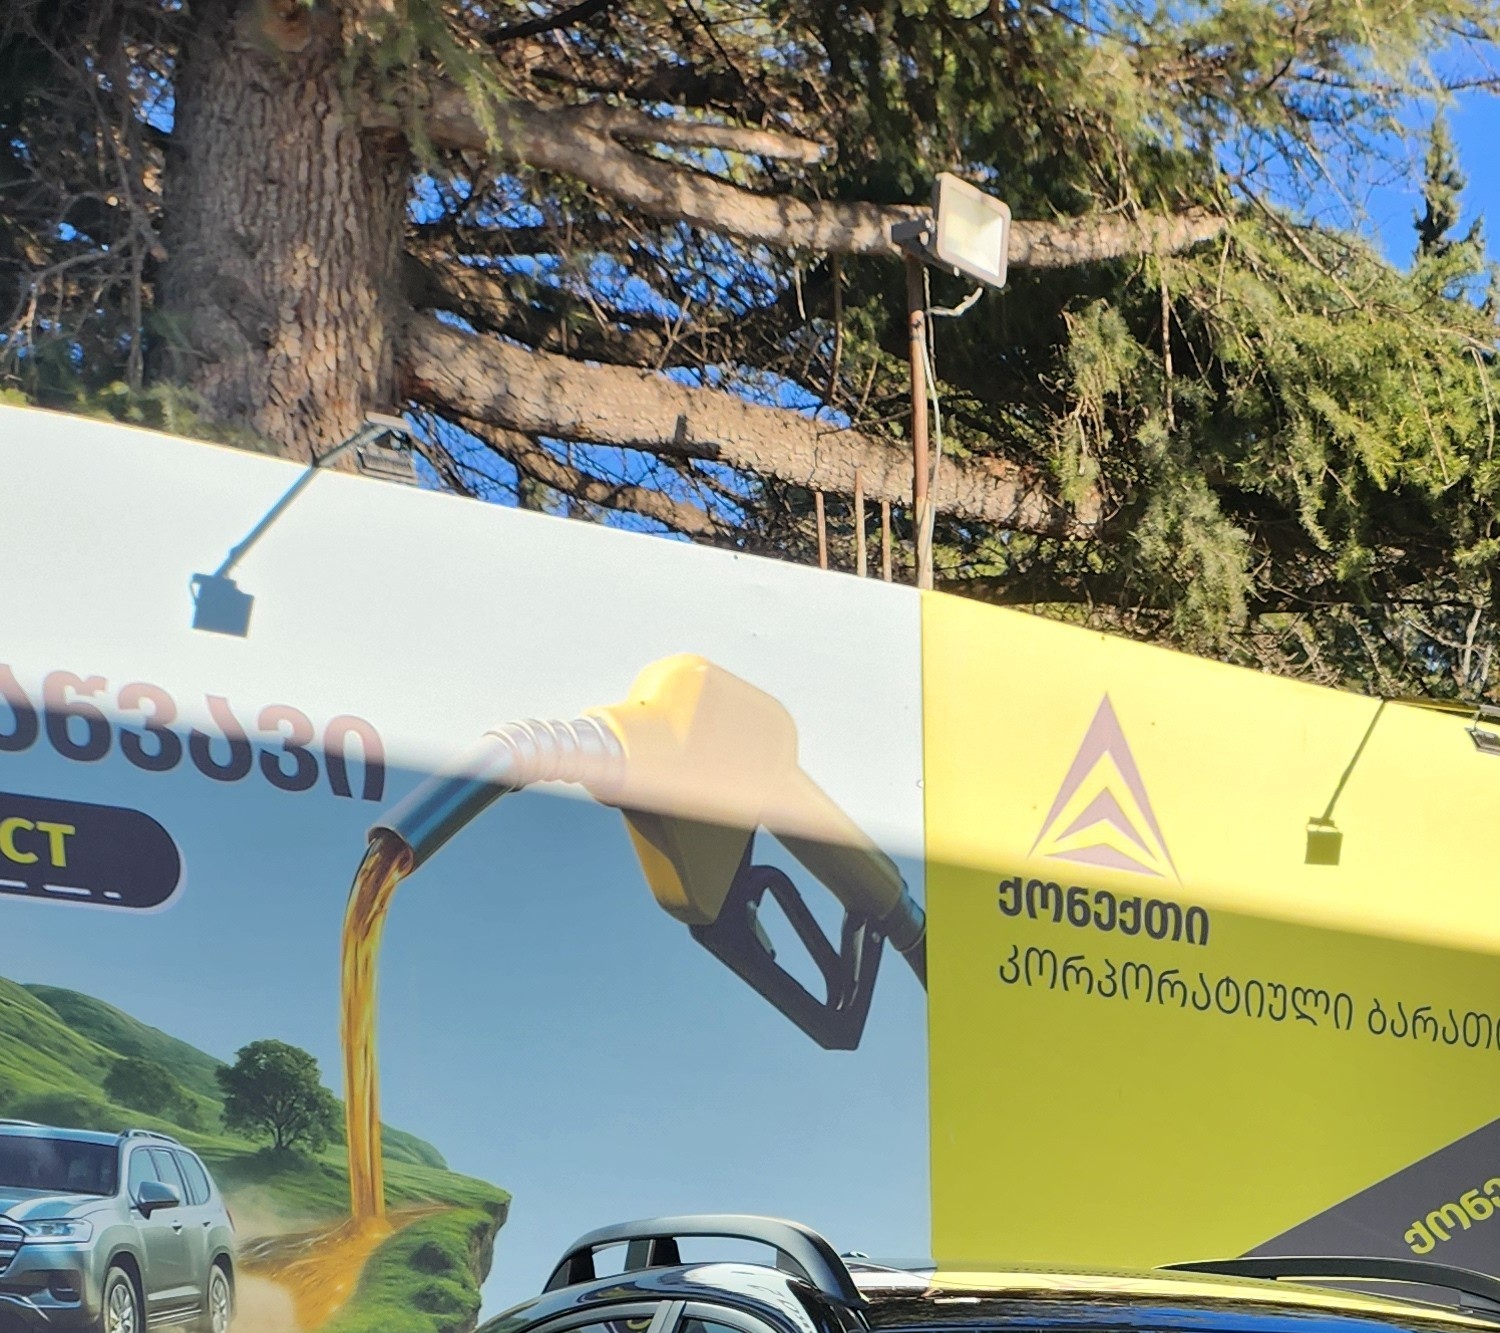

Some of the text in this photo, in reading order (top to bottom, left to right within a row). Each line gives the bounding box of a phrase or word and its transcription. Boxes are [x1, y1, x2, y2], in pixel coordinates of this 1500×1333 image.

[0, 817, 76, 867] CT
[997, 876, 1210, 945] ქონექთი
[999, 944, 1353, 1030] კორპორატიული
